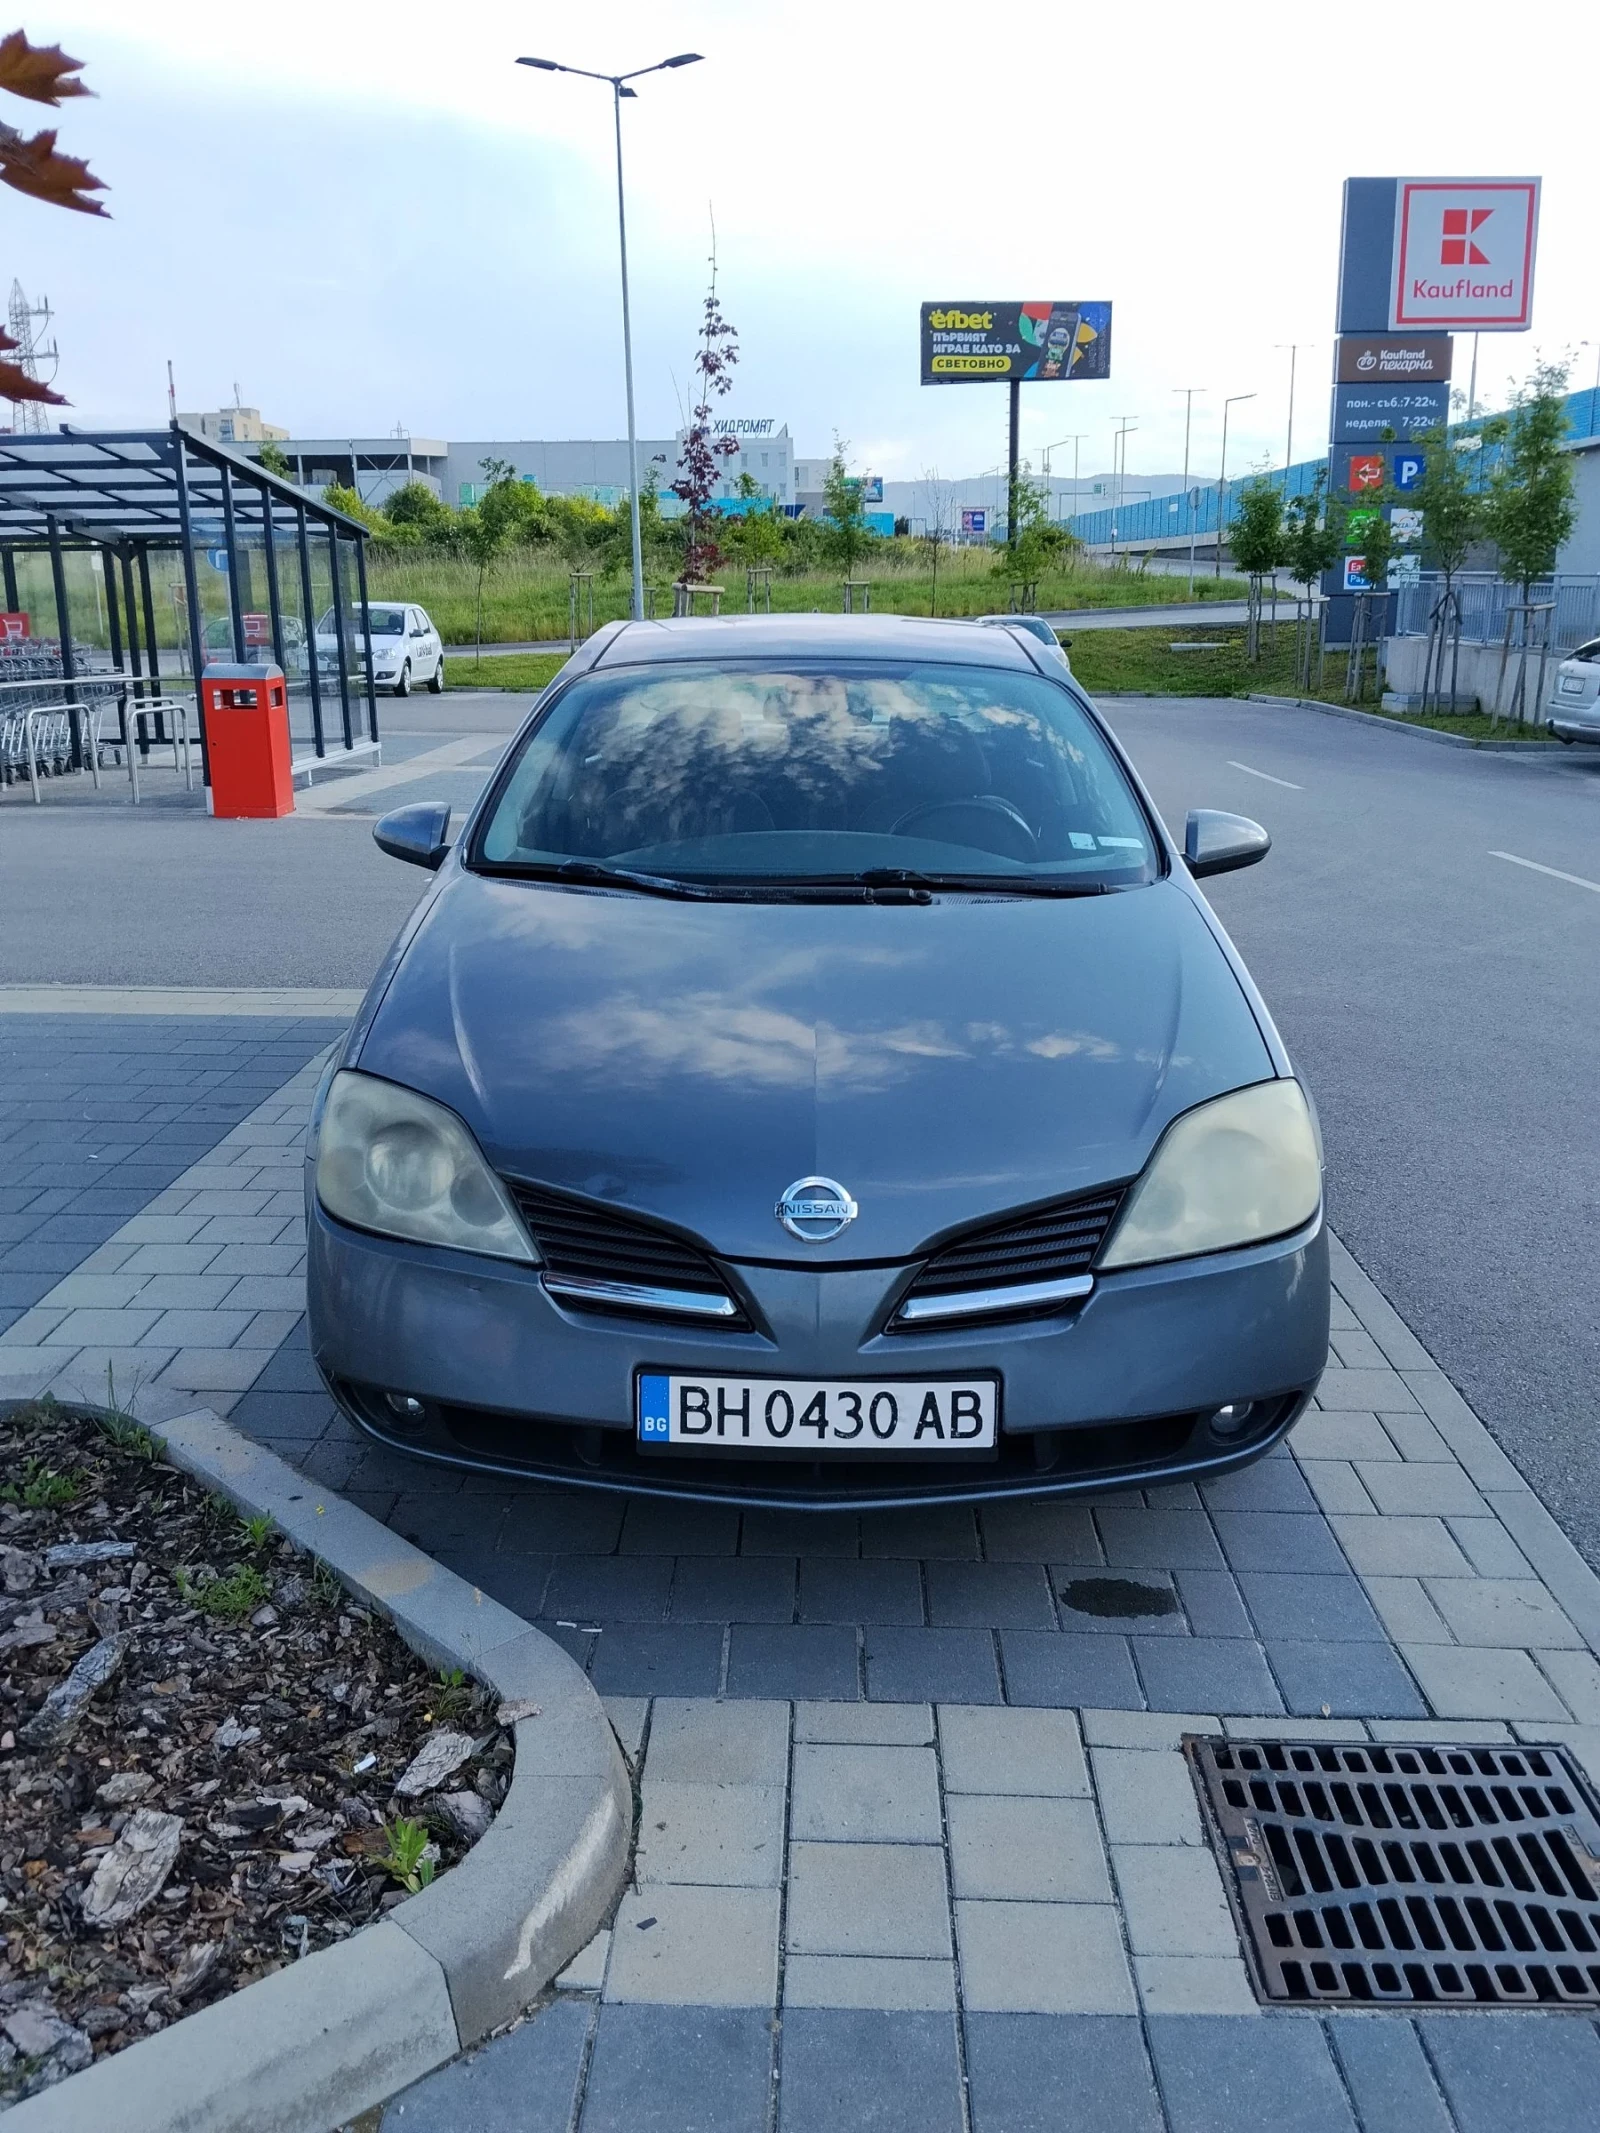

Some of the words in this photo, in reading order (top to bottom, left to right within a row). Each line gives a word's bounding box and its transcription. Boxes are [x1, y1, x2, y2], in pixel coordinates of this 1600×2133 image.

[1413, 280, 1514, 298] Kaufland
[931, 310, 993, 329] efbet
[933, 333, 987, 342] ПЪРВИЯТ
[933, 344, 970, 353] ИГРАЕ
[973, 344, 1003, 353] КАТО
[1006, 344, 1021, 353] ЗА
[1380, 349, 1426, 360] Kaufland
[937, 359, 1005, 368] СВЕТОВНО
[1379, 360, 1434, 373] пекарна
[1345, 419, 1391, 430] неделя:
[1402, 461, 1418, 483] P
[1350, 575, 1364, 584] Pay
[783, 1203, 849, 1215] NISSAN
[764, 1389, 898, 1439] 0430
[914, 1390, 983, 1439] AB
[644, 1417, 667, 1433] BG
